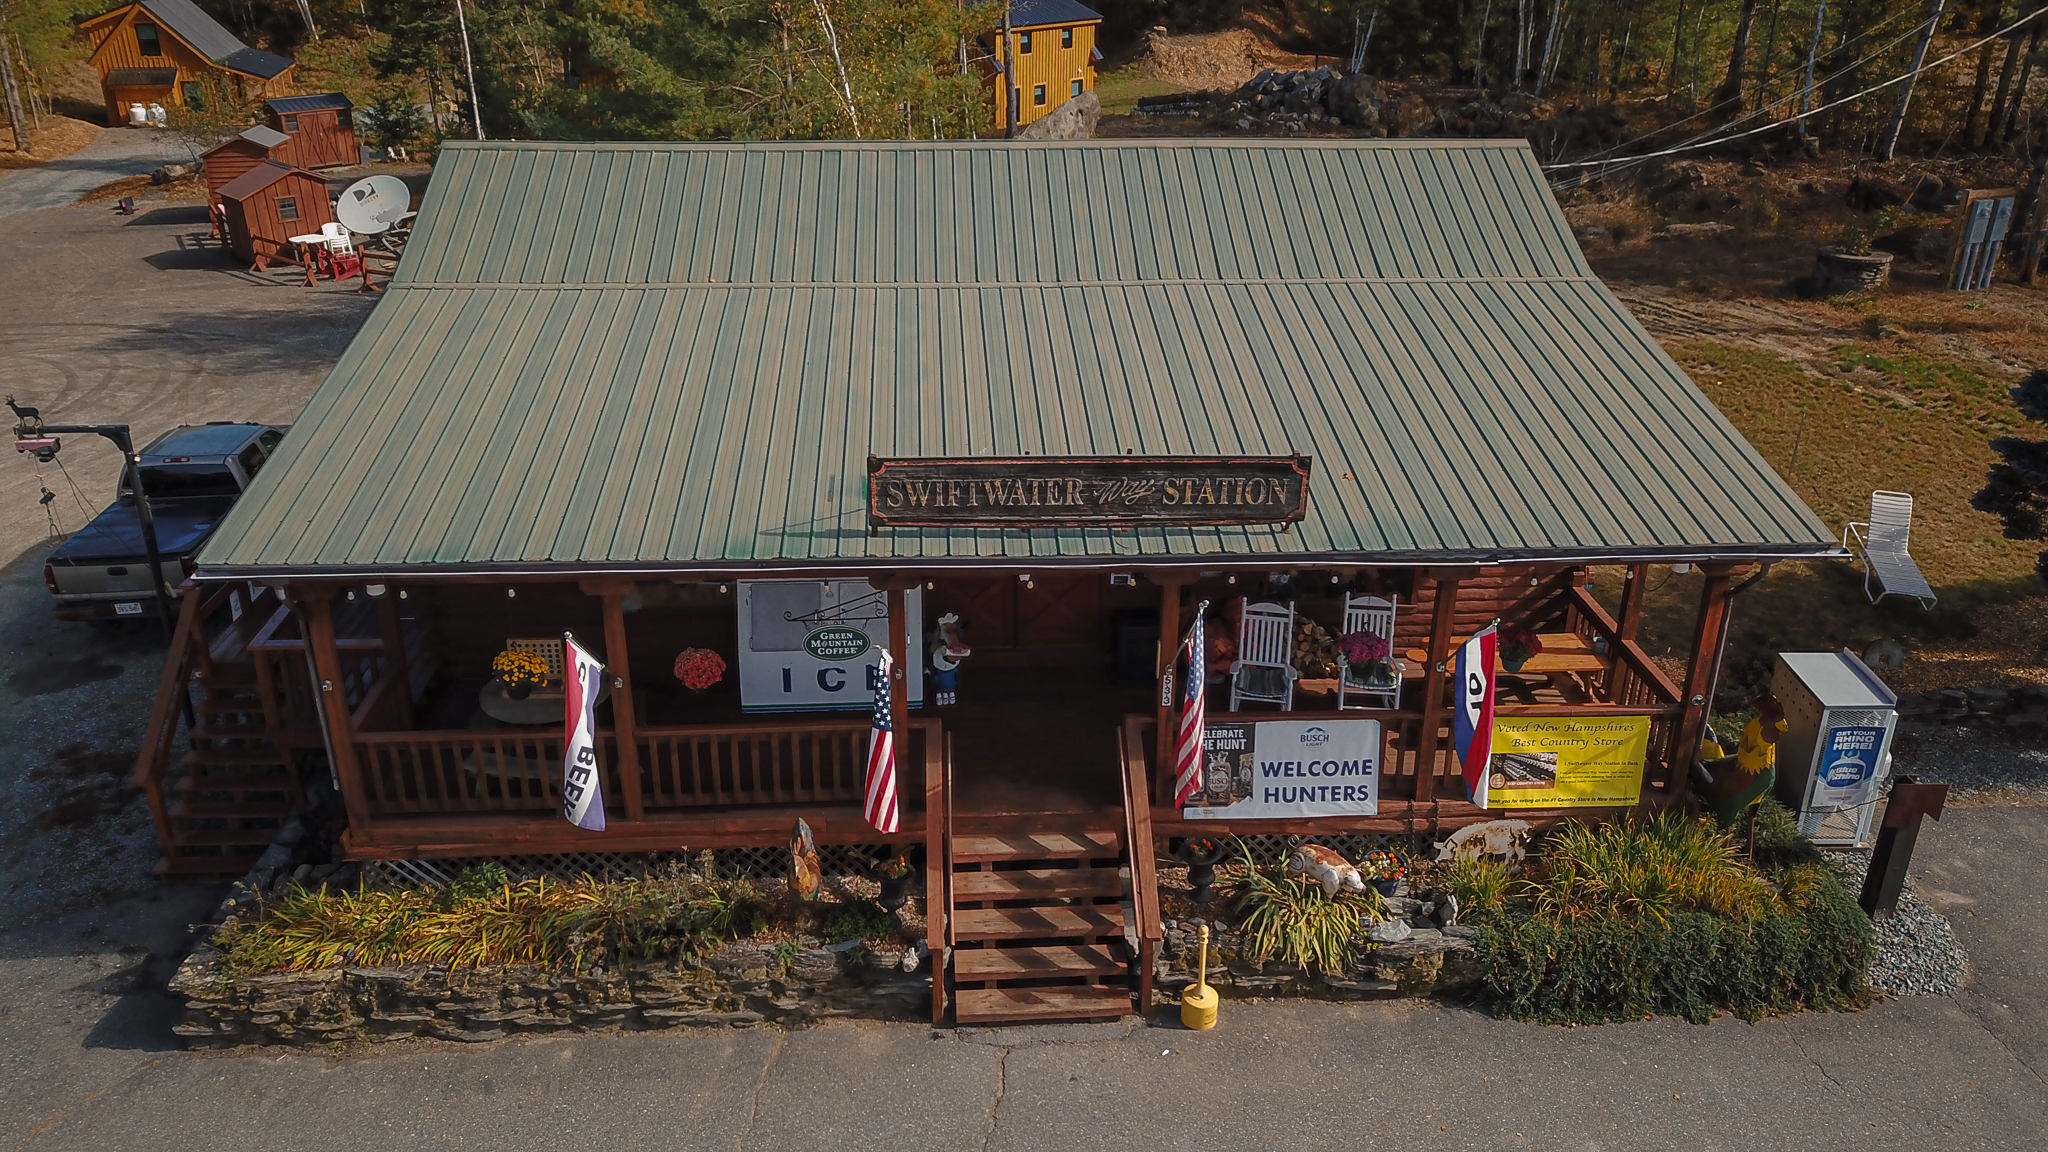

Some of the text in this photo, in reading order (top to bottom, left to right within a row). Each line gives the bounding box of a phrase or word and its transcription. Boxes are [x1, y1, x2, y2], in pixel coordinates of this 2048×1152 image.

[886, 476, 1290, 508] SWIFTWATER Way STATION
[820, 632, 853, 640] GREEN
[811, 639, 863, 648] MOUNTAIN
[817, 647, 857, 655] COFFEE
[1496, 721, 1635, 736] Voted New Hampshires
[1203, 729, 1244, 739] ELEBRATE
[1300, 734, 1330, 743] BUSCH
[1834, 735, 1875, 743] RHINO
[1203, 738, 1247, 750] HE HUNT
[1511, 736, 1624, 750] Best Country Store
[1833, 742, 1873, 750] HERE!
[1260, 759, 1373, 778] WELCOME
[1264, 785, 1369, 804] HUNTERS
